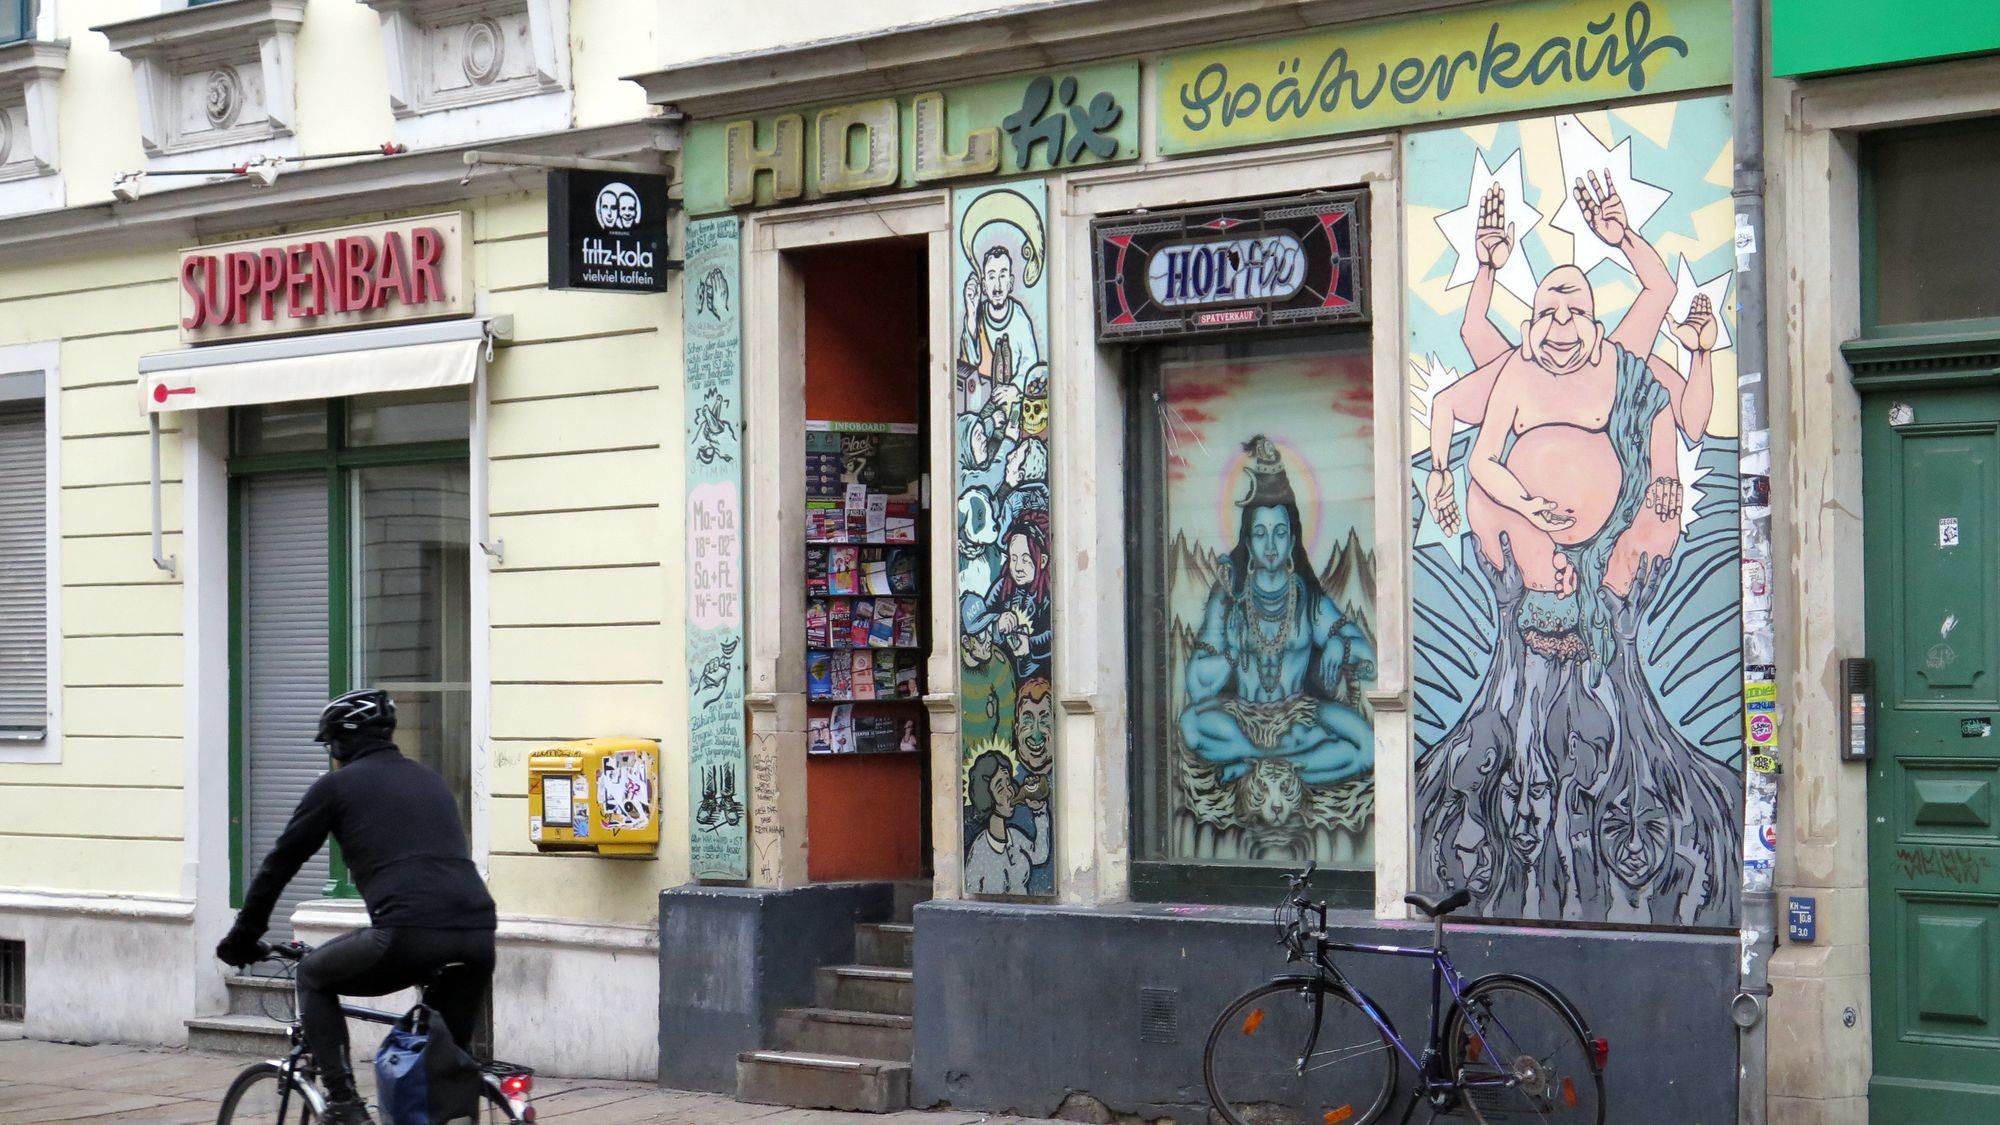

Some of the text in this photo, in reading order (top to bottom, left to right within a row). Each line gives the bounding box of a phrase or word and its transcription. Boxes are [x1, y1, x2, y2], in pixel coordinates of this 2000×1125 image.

[582, 237, 653, 268] fritz-kola
[182, 227, 445, 329] SUPPENBAR
[582, 268, 654, 285] vielviel koffein
[834, 422, 885, 432] INFOBOARD
[841, 434, 871, 451] Black
[1790, 901, 1799, 911] KH
